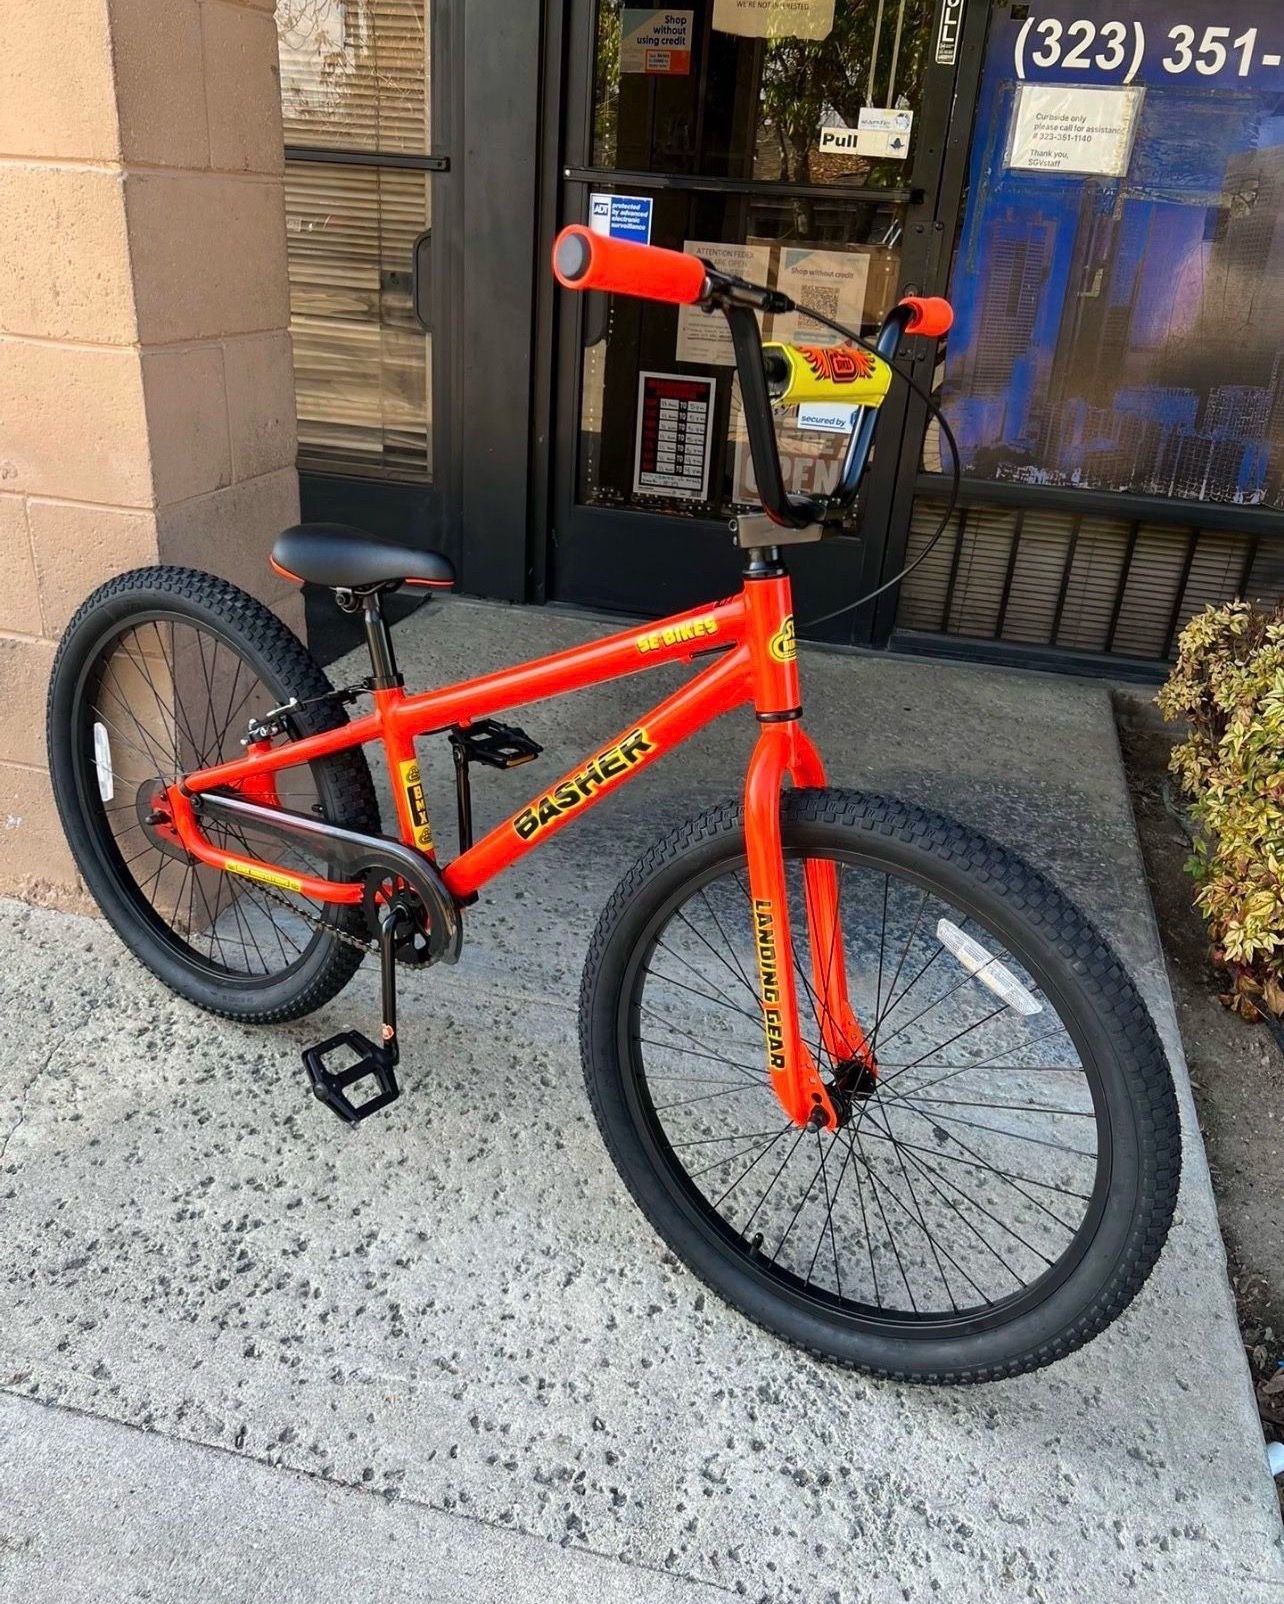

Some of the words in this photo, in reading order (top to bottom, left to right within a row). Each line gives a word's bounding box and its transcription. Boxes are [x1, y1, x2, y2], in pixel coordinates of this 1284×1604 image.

[665, 15, 687, 26] Shop
[653, 25, 687, 35] without
[636, 36, 660, 46] using
[661, 36, 686, 45] credit
[1014, 17, 1145, 83] (323)
[1163, 24, 1281, 76] 351-
[1036, 113, 1069, 122] Curbside
[1070, 114, 1087, 124] only
[1034, 123, 1059, 131] please
[1059, 124, 1073, 132] call
[822, 132, 858, 148] Pull
[1039, 133, 1092, 142] 323-351-1140
[1030, 149, 1052, 158] Thank
[594, 203, 609, 215] ADT
[696, 247, 733, 257] ATTENTION
[791, 266, 808, 276] Shop
[809, 268, 834, 277] without
[834, 271, 854, 280] credit
[800, 415, 835, 425] secured
[835, 417, 846, 427] by
[636, 634, 660, 654] SE
[661, 615, 719, 647] BIKES
[512, 728, 654, 841] BASHER
[412, 784, 429, 825] BMX
[755, 899, 780, 1003] LANDING
[766, 1009, 785, 1070] GEAR
